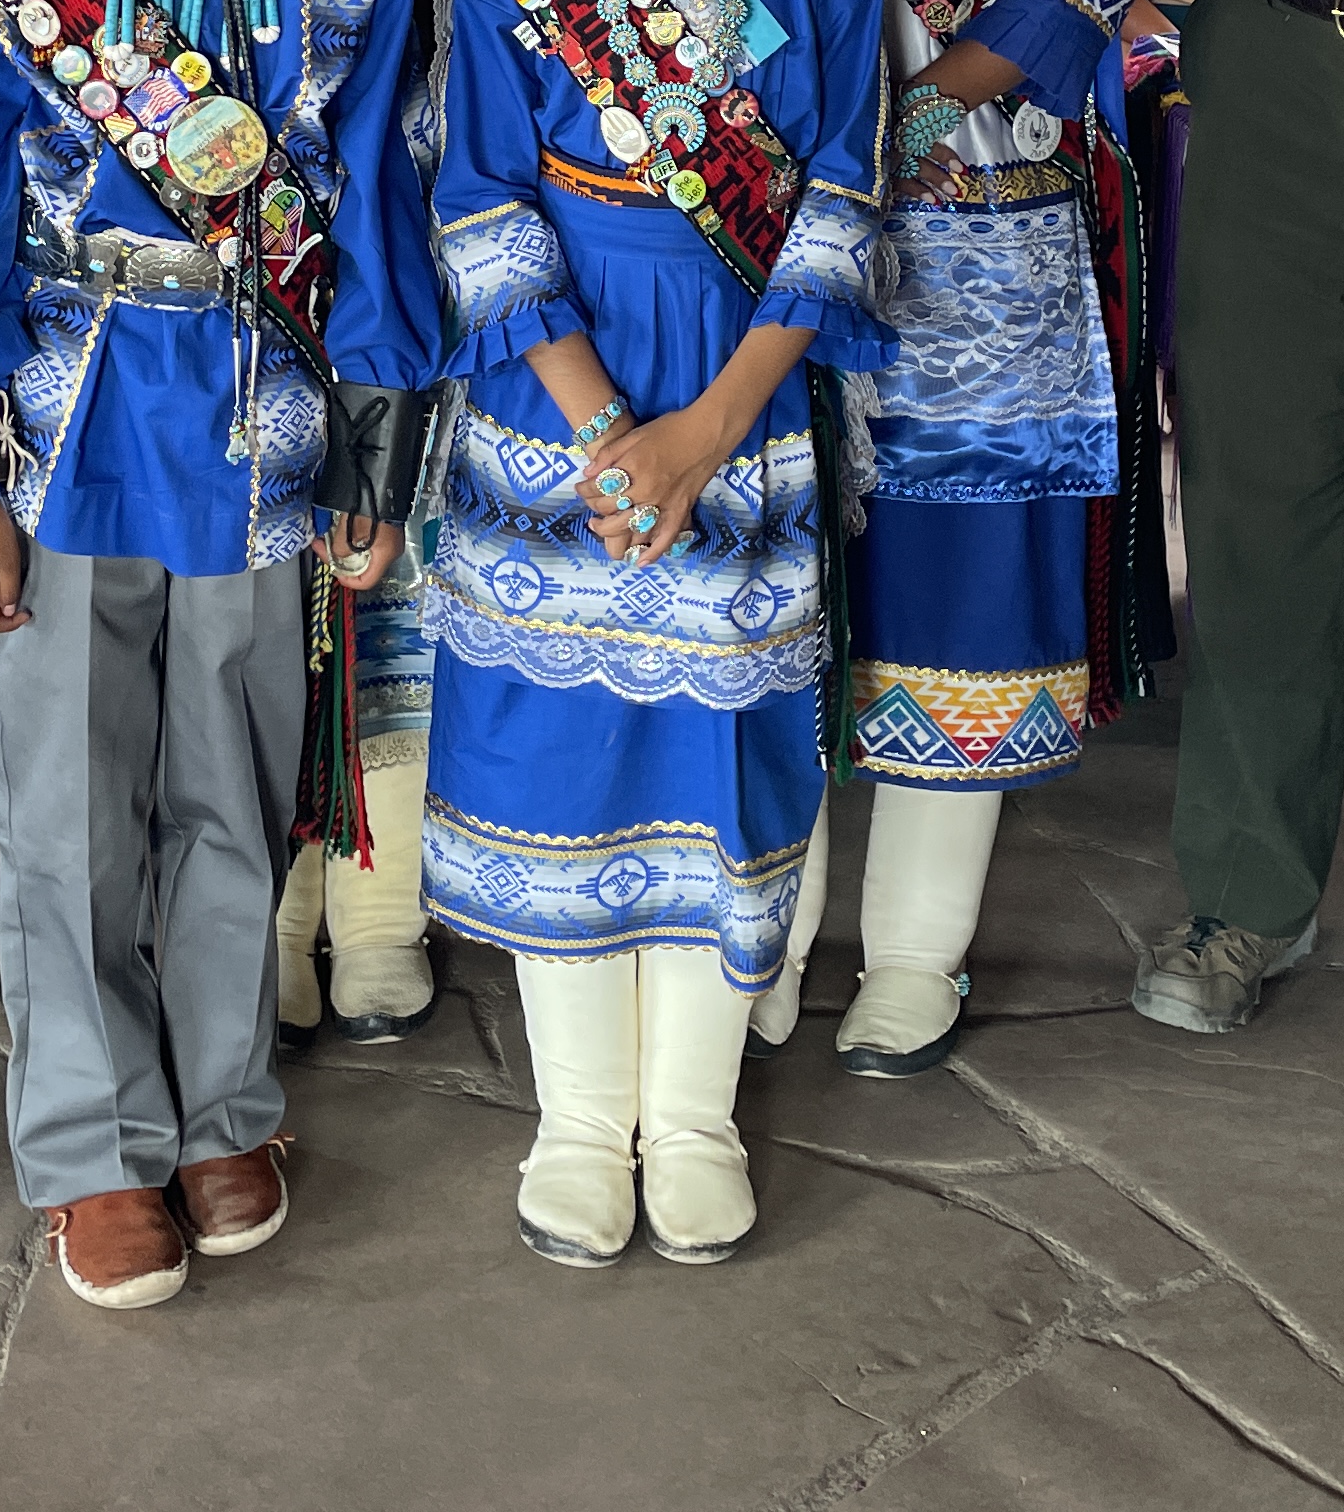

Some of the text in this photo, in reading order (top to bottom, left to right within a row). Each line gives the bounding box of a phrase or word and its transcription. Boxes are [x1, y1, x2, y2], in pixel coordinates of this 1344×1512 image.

[177, 61, 192, 77] He
[188, 64, 207, 85] Him
[655, 160, 675, 180] LIFE
[673, 174, 694, 198] She
[685, 183, 704, 204] Her
